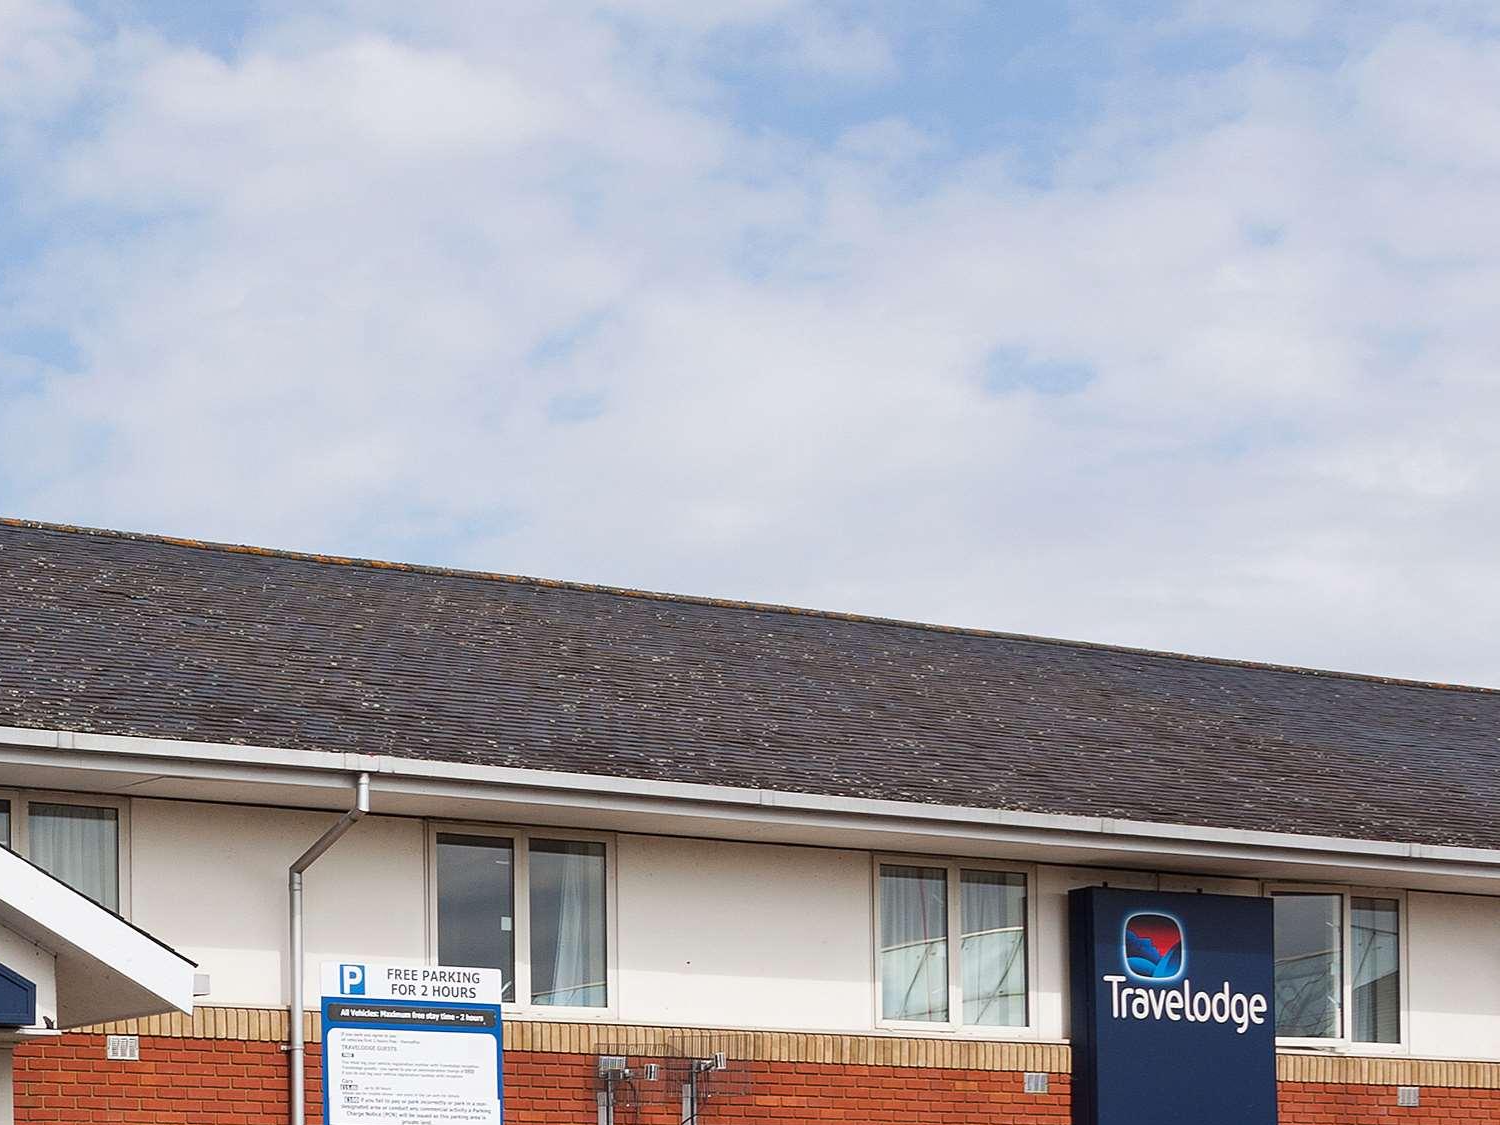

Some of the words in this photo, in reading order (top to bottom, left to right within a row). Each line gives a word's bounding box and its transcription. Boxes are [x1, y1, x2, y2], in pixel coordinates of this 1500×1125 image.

[343, 966, 363, 994] P
[387, 968, 418, 981] FREE
[422, 970, 480, 984] PARKING
[391, 983, 417, 996] FOR
[421, 985, 428, 997] 2
[432, 986, 477, 999] HOURS
[1102, 975, 1268, 1034] Travelodge
[340, 1008, 350, 1017] All
[350, 1008, 380, 1018] Vehicles:
[380, 1009, 411, 1019] Maximum
[411, 1010, 426, 1020] free
[426, 1011, 440, 1022] stay
[440, 1012, 455, 1021] time
[459, 1013, 465, 1021] 2
[465, 1013, 484, 1022] hours
